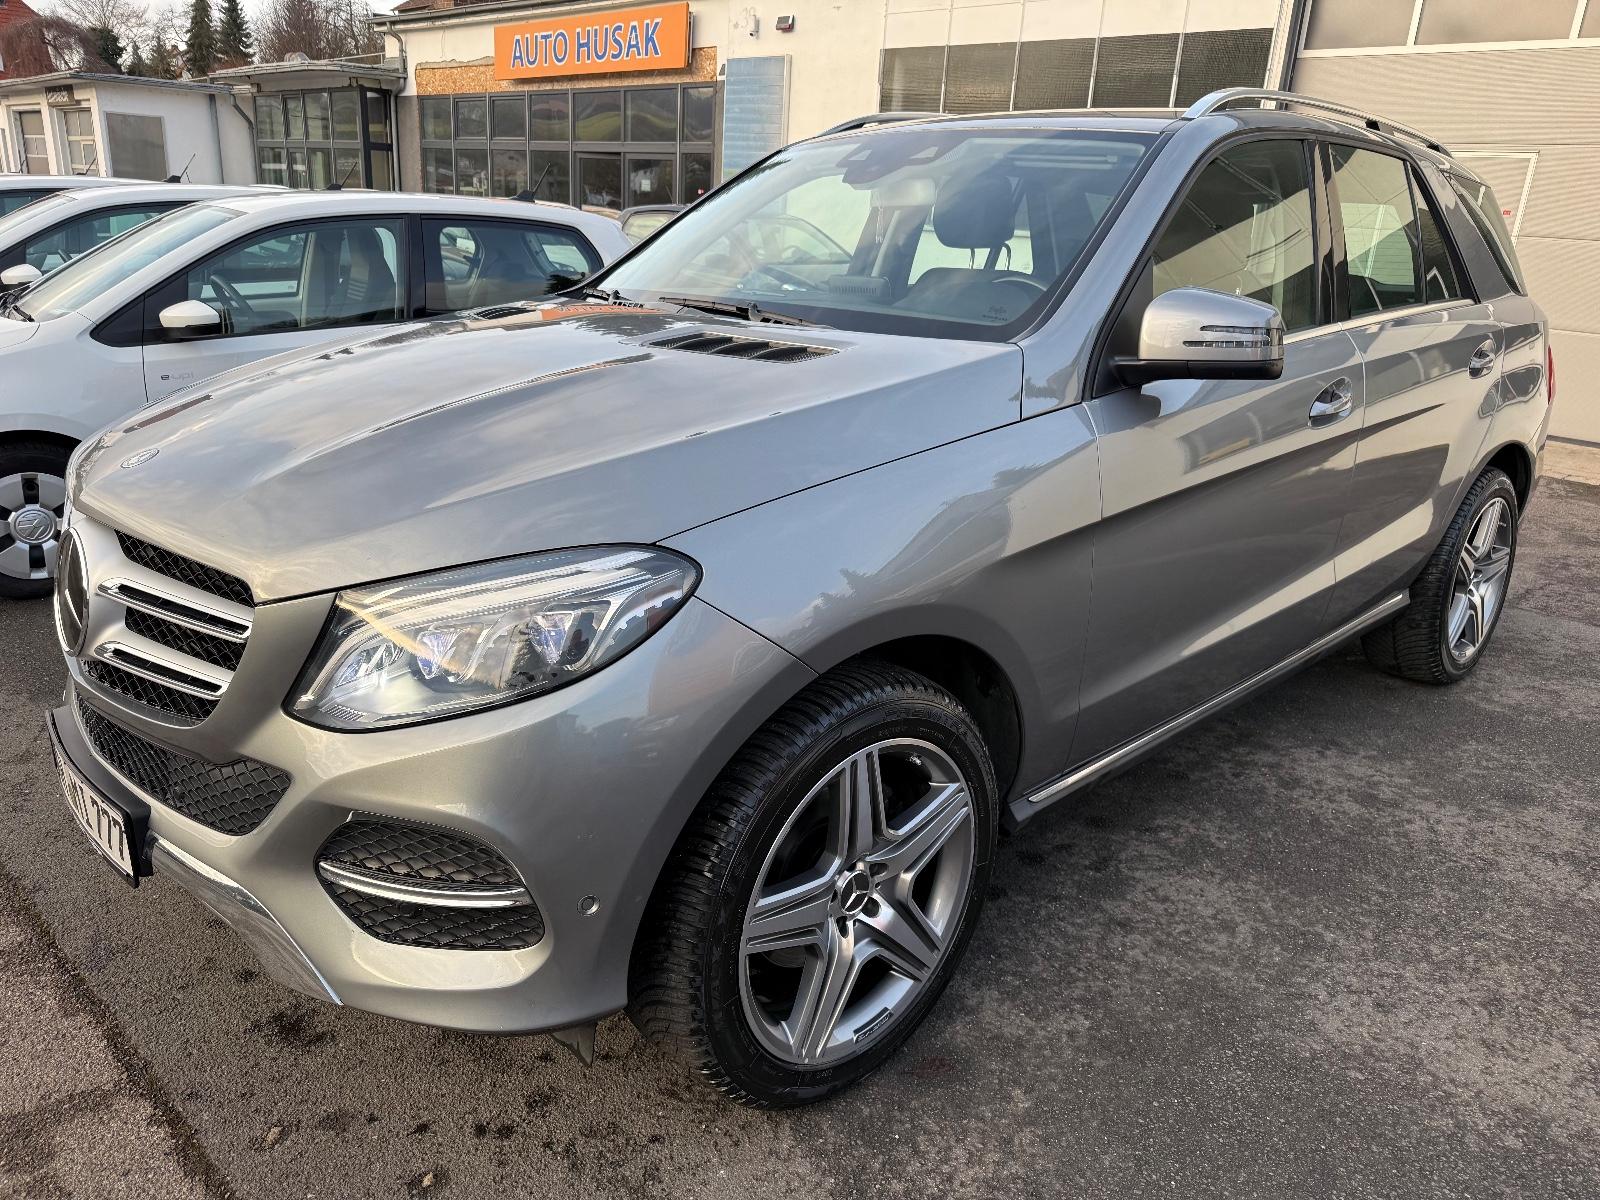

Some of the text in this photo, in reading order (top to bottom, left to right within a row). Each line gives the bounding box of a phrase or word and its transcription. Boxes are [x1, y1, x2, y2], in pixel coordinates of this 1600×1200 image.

[510, 17, 662, 69] AUTO HUSAK
[90, 795, 125, 862] 777
